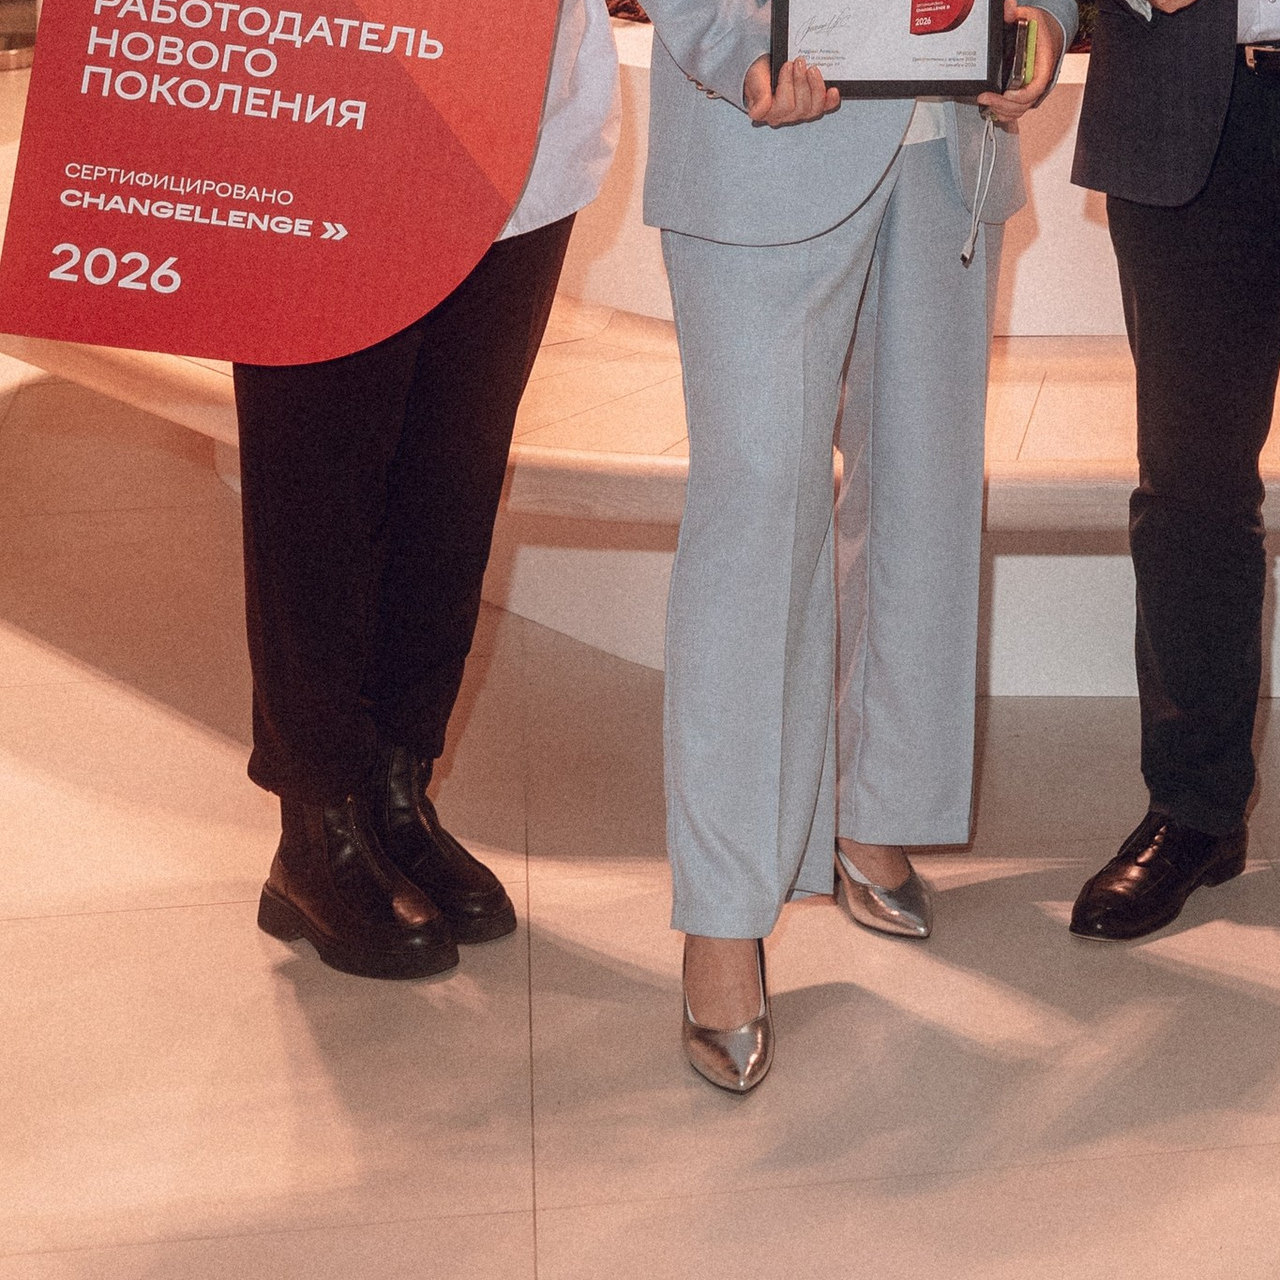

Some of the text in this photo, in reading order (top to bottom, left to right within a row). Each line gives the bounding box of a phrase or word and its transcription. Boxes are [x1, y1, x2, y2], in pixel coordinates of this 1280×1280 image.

[87, 26, 277, 79] НОВОГО
[81, 65, 367, 130] ПОКОЛЕНИЯ
[65, 163, 293, 205] СЕРТИФИЦИРОВАНО
[60, 189, 312, 236] CHANGELLENGE
[49, 243, 182, 293] 2026
